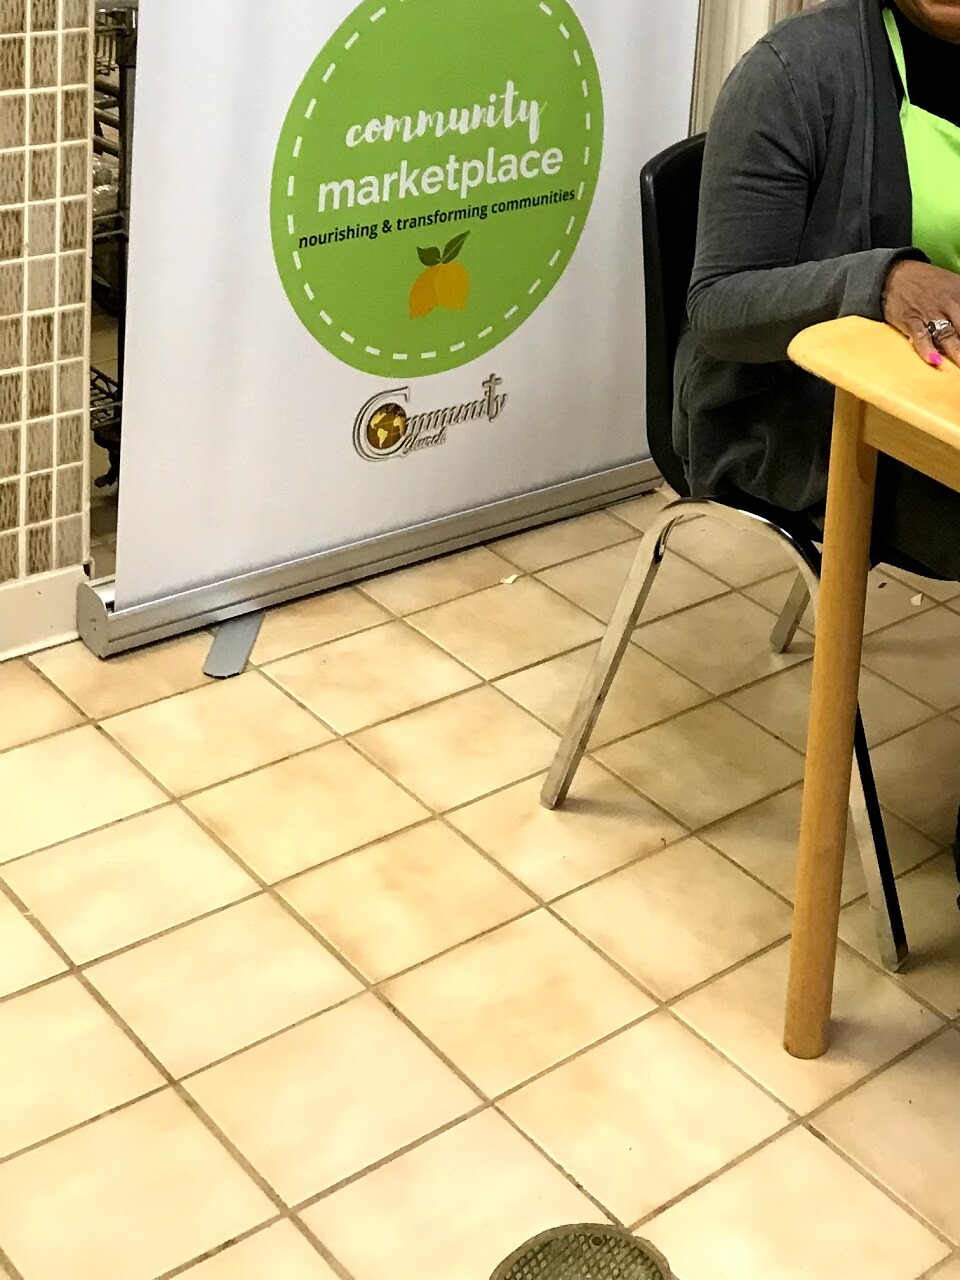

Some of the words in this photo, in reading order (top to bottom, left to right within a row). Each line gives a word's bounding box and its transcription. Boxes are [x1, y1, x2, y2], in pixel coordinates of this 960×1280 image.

[344, 79, 549, 145] community
[317, 146, 564, 213] marketplace
[298, 224, 379, 249] nourishing
[381, 219, 392, 234] &
[396, 204, 489, 231] transforming
[491, 189, 576, 214] communities
